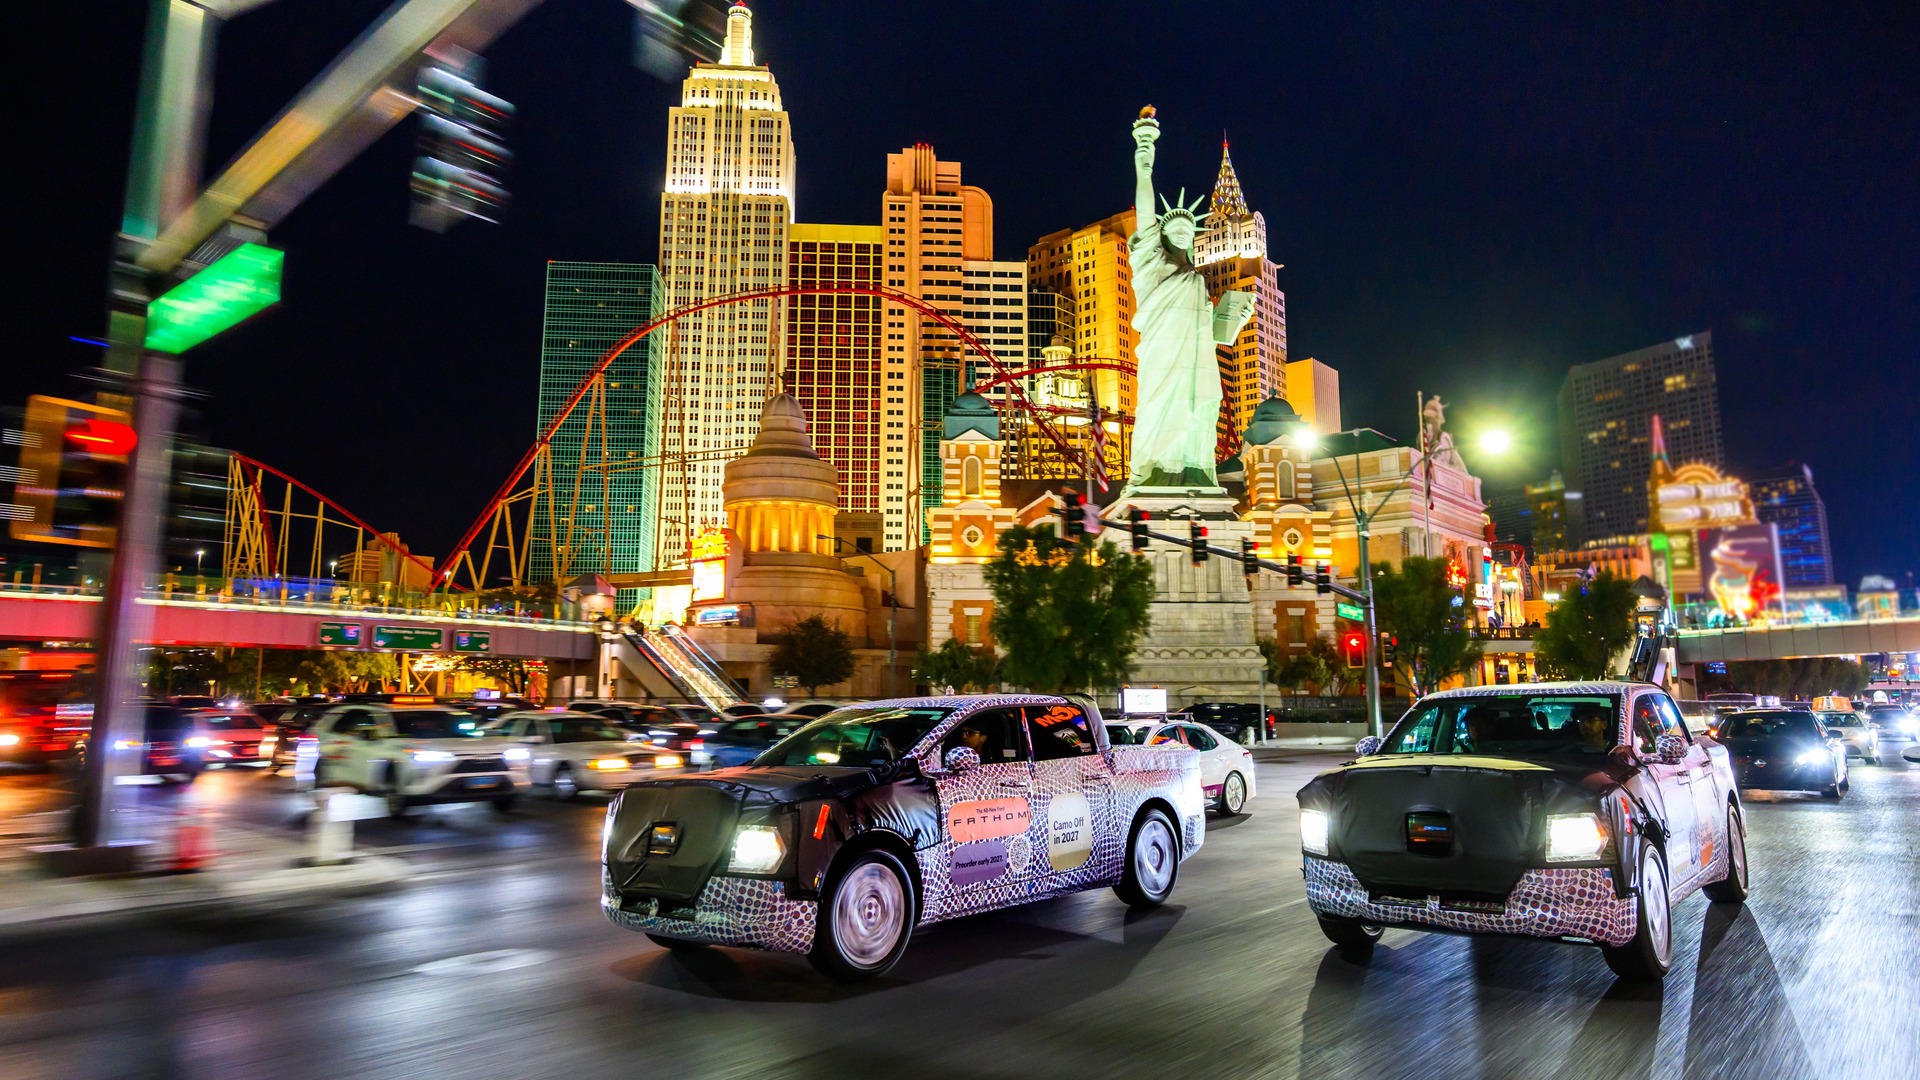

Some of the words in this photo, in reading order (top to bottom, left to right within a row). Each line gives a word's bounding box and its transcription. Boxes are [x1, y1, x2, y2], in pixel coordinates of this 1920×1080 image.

[953, 811, 1027, 827] FATHOM
[1053, 820, 1073, 831] Camo
[1073, 816, 1084, 828] Off
[1053, 834, 1061, 845] in
[1061, 831, 1079, 844] 2027
[955, 859, 977, 870] Preorder
[977, 857, 990, 866] early
